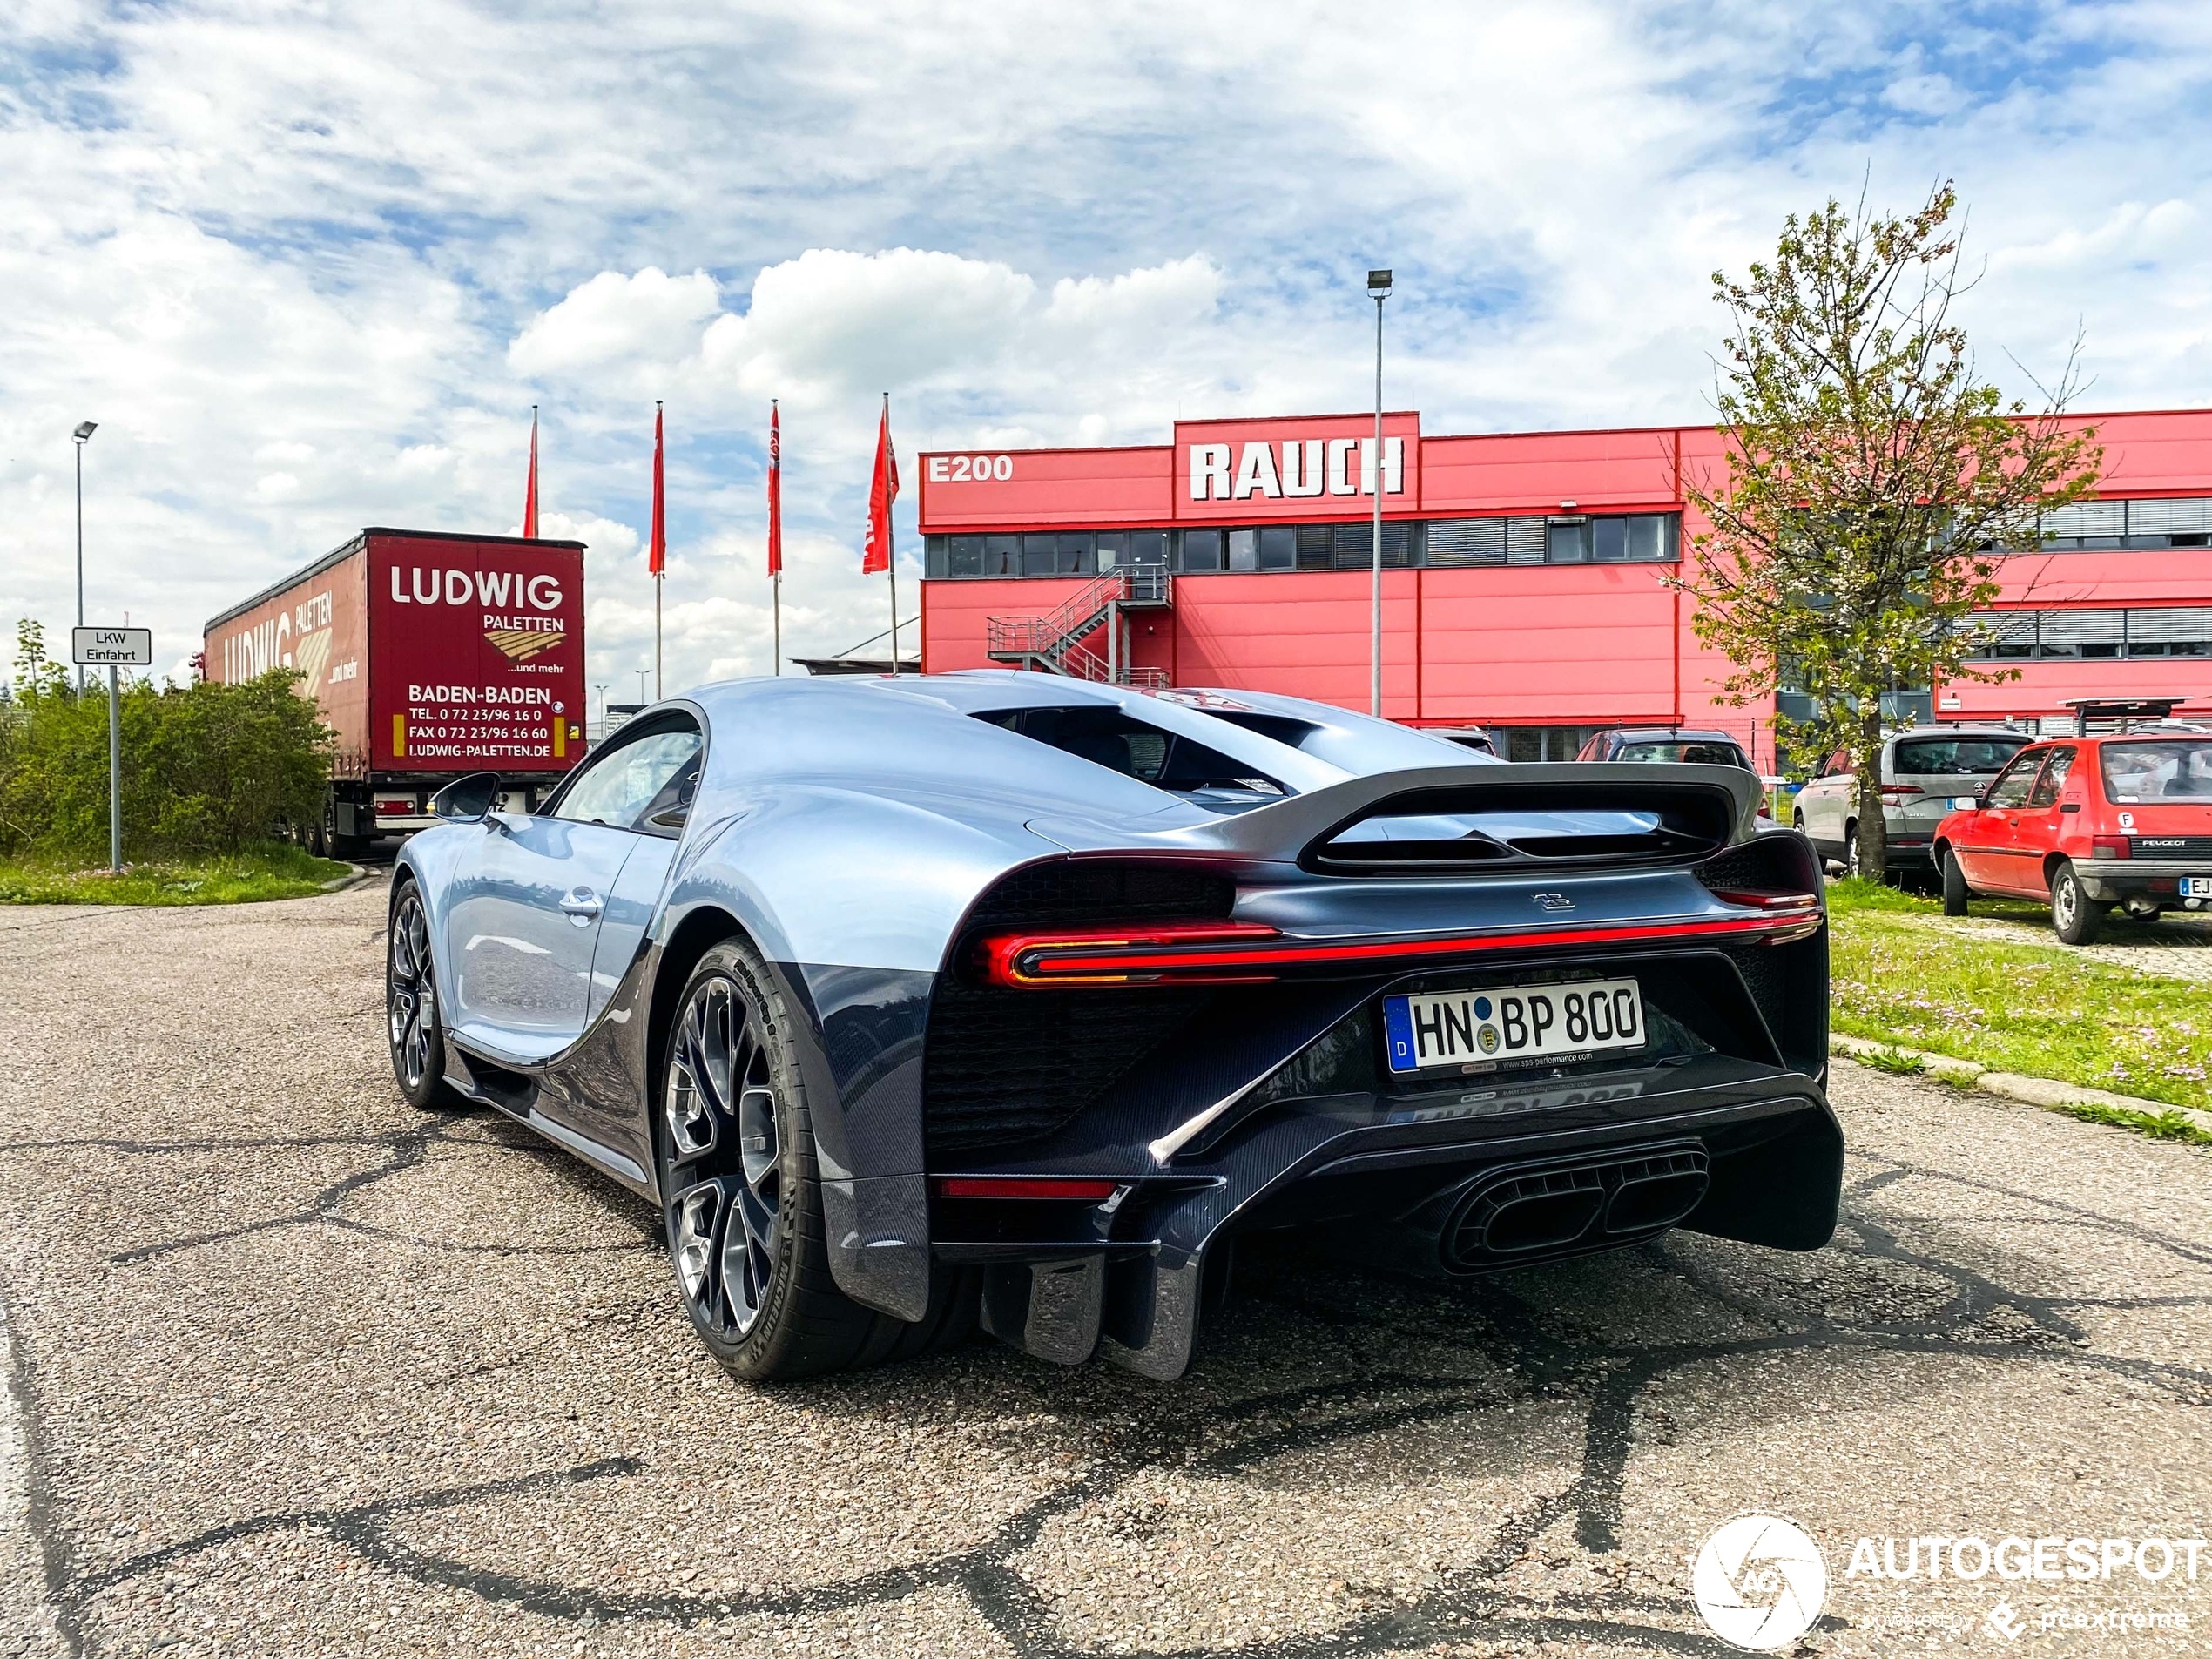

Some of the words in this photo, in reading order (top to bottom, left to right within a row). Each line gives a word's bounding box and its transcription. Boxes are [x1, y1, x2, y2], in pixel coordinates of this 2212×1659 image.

[928, 455, 1014, 482] E200
[1190, 436, 1404, 501] RAUCH
[392, 565, 563, 610] LUDWIG
[295, 590, 332, 637] PALETTEN
[483, 614, 563, 631] PALETTEN
[96, 633, 126, 644] LKW
[86, 649, 136, 660] Einfahrt
[538, 664, 564, 673] mehr
[408, 685, 550, 704] BADEN-BADEN
[409, 708, 437, 719] TEL.
[440, 709, 448, 720] 0
[452, 709, 469, 720] 72
[472, 709, 510, 721] 23/96
[514, 710, 529, 721] 16
[533, 710, 542, 721] 0
[409, 726, 435, 738] FAX
[437, 727, 446, 738] 0
[449, 727, 466, 738] 72
[470, 727, 509, 739] 23/96
[513, 727, 529, 738] 16
[532, 728, 548, 738] 60
[409, 745, 550, 757] LUDWIG-PALETTEN.DE
[2122, 814, 2130, 825] F
[1413, 1001, 1474, 1057] HN
[1500, 996, 1554, 1049] BP
[1564, 989, 1637, 1043] 800
[1396, 1041, 1407, 1056] D
[763, 1262, 789, 1340] MICHELIN
